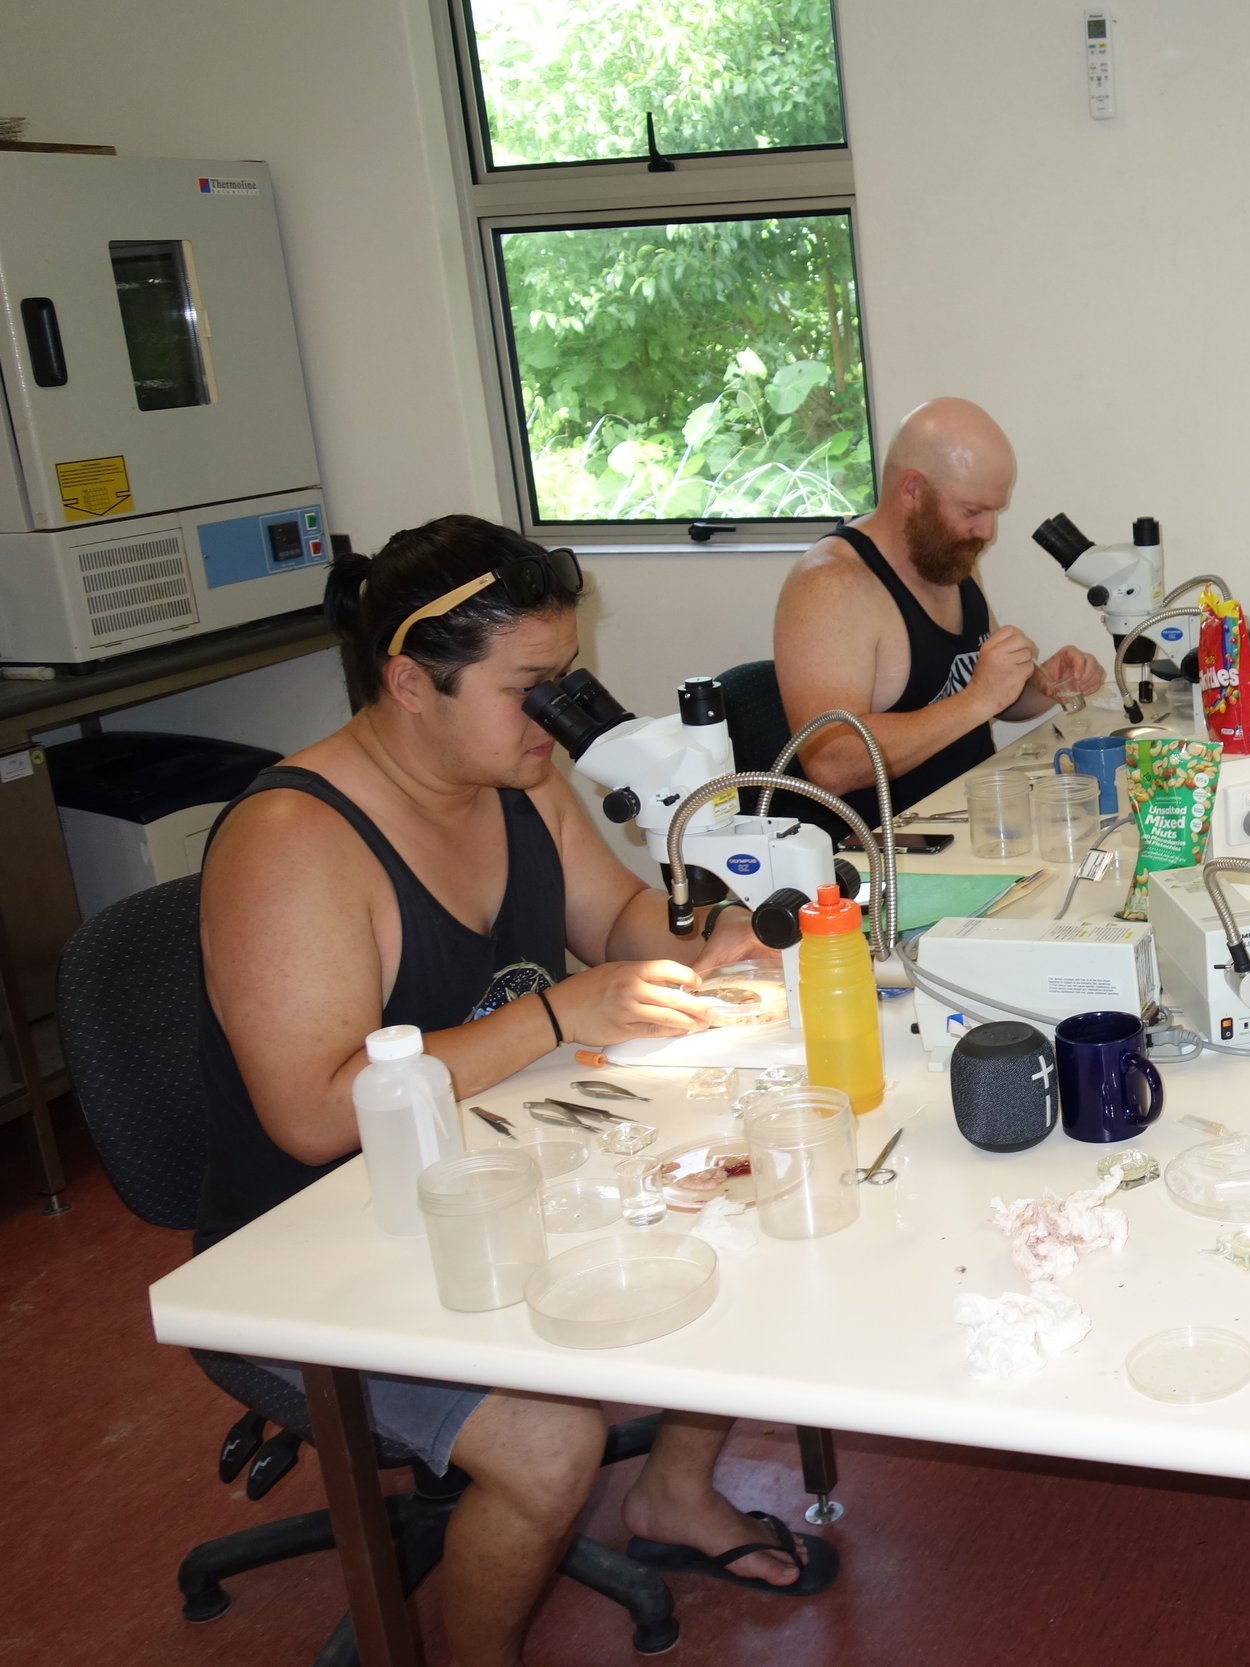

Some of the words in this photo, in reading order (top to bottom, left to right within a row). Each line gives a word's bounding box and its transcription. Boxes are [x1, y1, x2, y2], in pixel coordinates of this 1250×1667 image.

[210, 179, 257, 189] Thermoline
[1149, 806, 1187, 815] Unsalted
[1145, 814, 1186, 828] Mixed
[1151, 827, 1177, 839] Nuts
